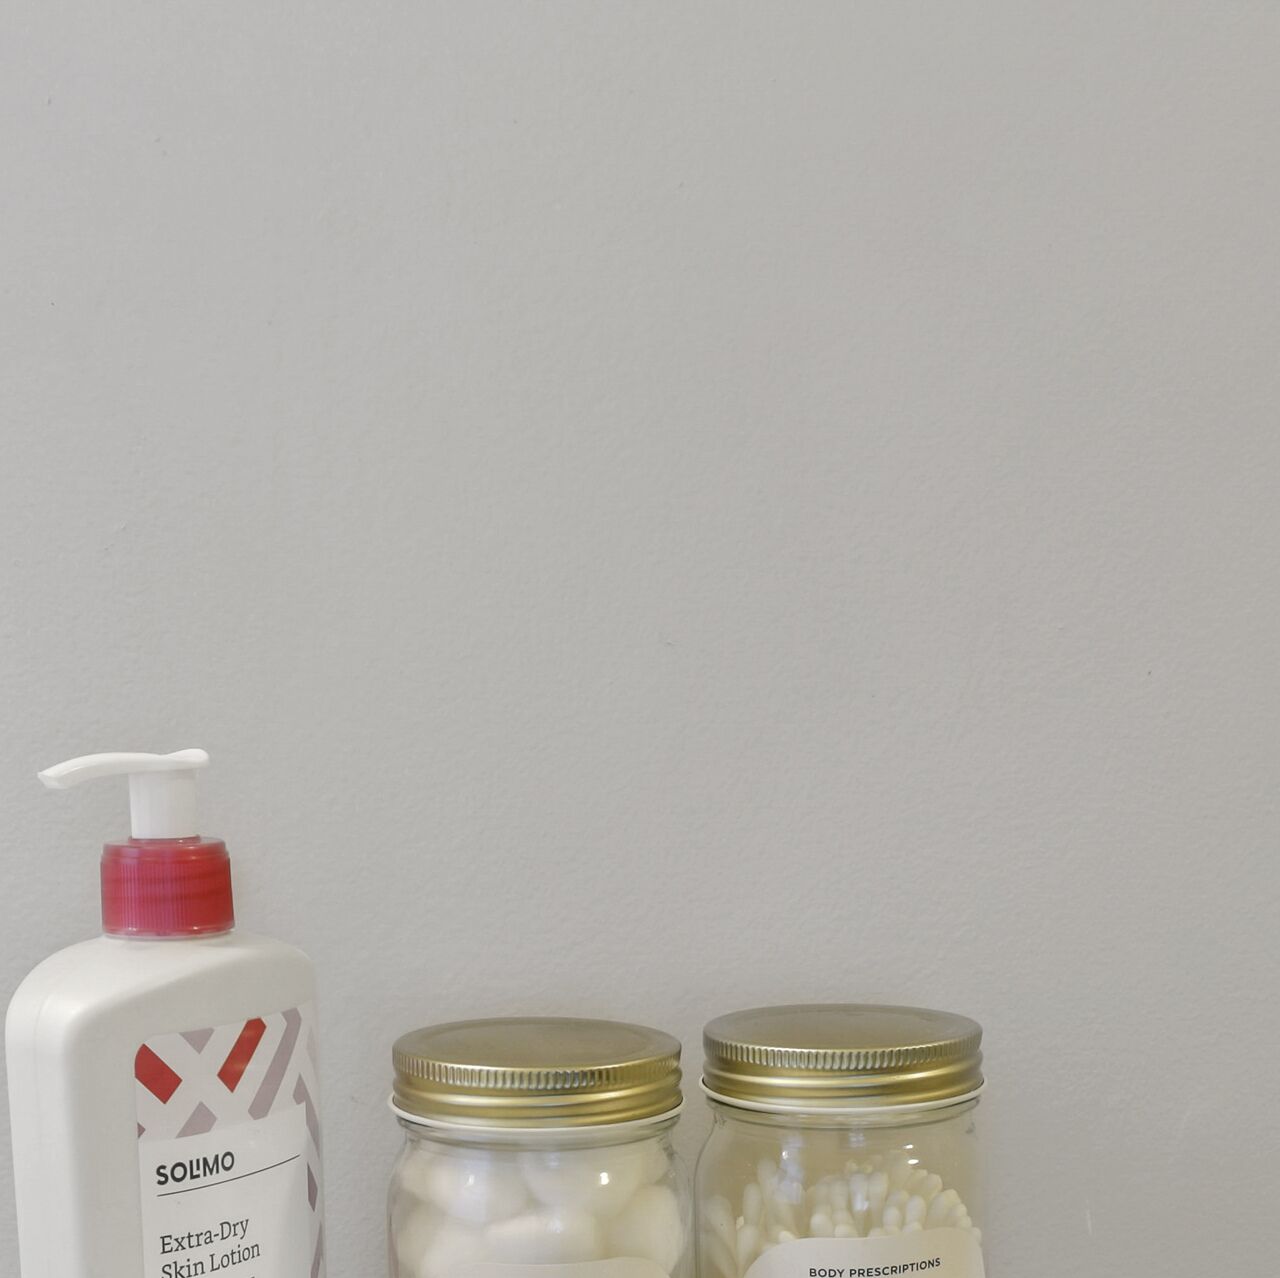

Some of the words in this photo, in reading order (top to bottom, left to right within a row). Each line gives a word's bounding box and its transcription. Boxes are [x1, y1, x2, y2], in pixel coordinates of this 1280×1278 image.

[156, 1151, 235, 1186] SOLIMO
[160, 1218, 249, 1255] Extra-Dry
[209, 1242, 261, 1273] Lotion
[809, 1268, 845, 1278] BODY
[849, 1257, 941, 1278] PRESCRIPTIONS
